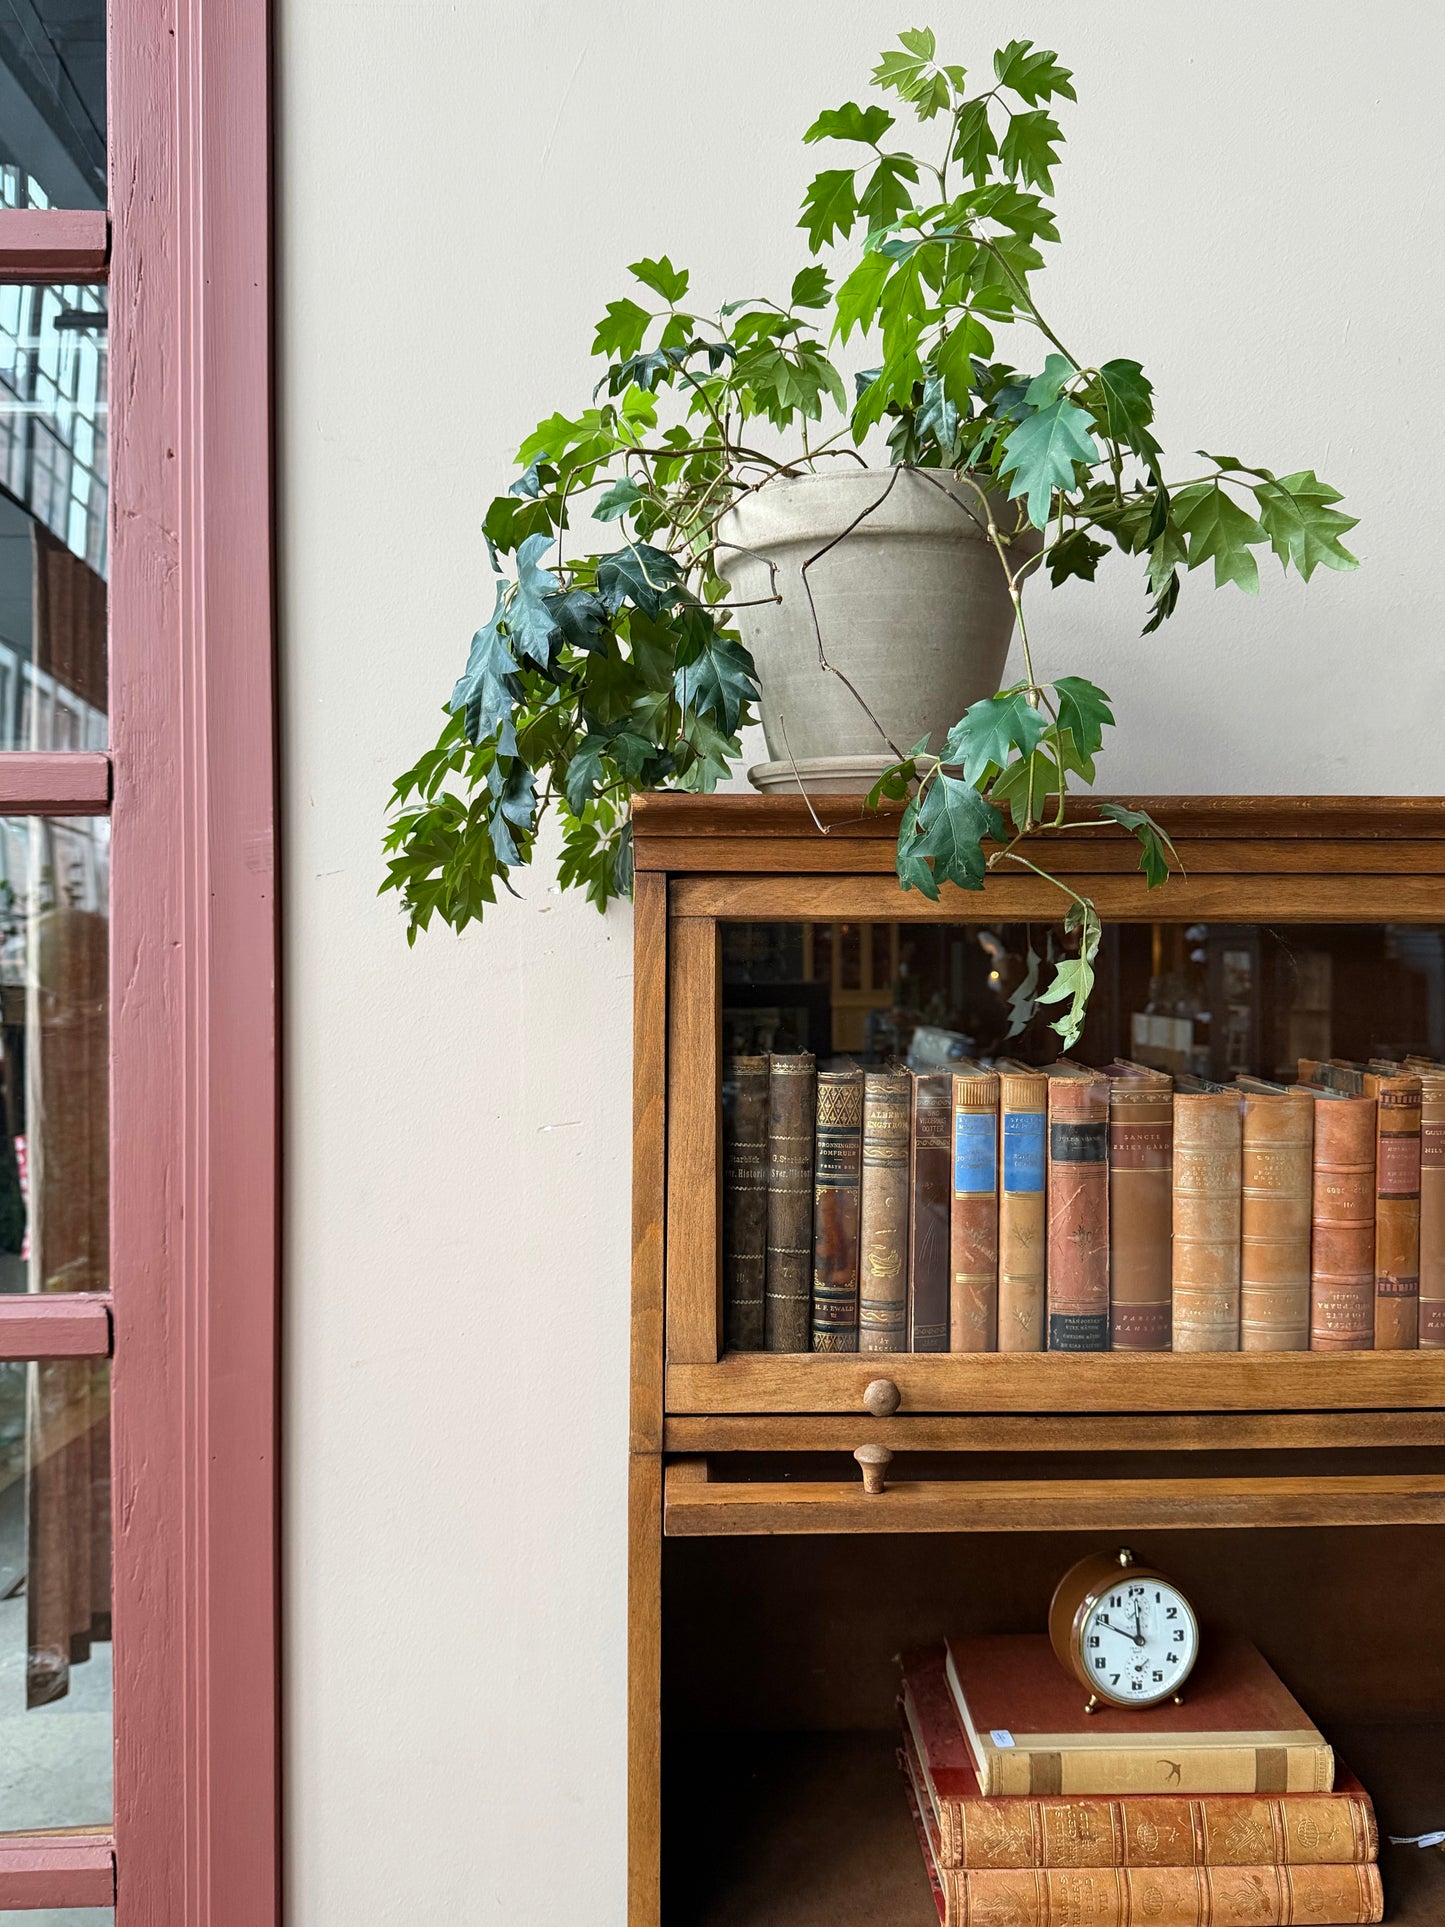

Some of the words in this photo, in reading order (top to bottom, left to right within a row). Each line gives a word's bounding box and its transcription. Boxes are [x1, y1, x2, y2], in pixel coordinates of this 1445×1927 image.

[1110, 1595, 1122, 1608] 11
[1155, 1591, 1161, 1604] 1
[1166, 1607, 1177, 1619] 2
[1173, 1629, 1184, 1642] 3
[1089, 1636, 1100, 1648] 9
[1095, 1657, 1106, 1669] 8
[1166, 1652, 1179, 1664] 4
[1109, 1673, 1121, 1685] 7
[1152, 1670, 1163, 1682] 5
[1131, 1680, 1143, 1691] 6
